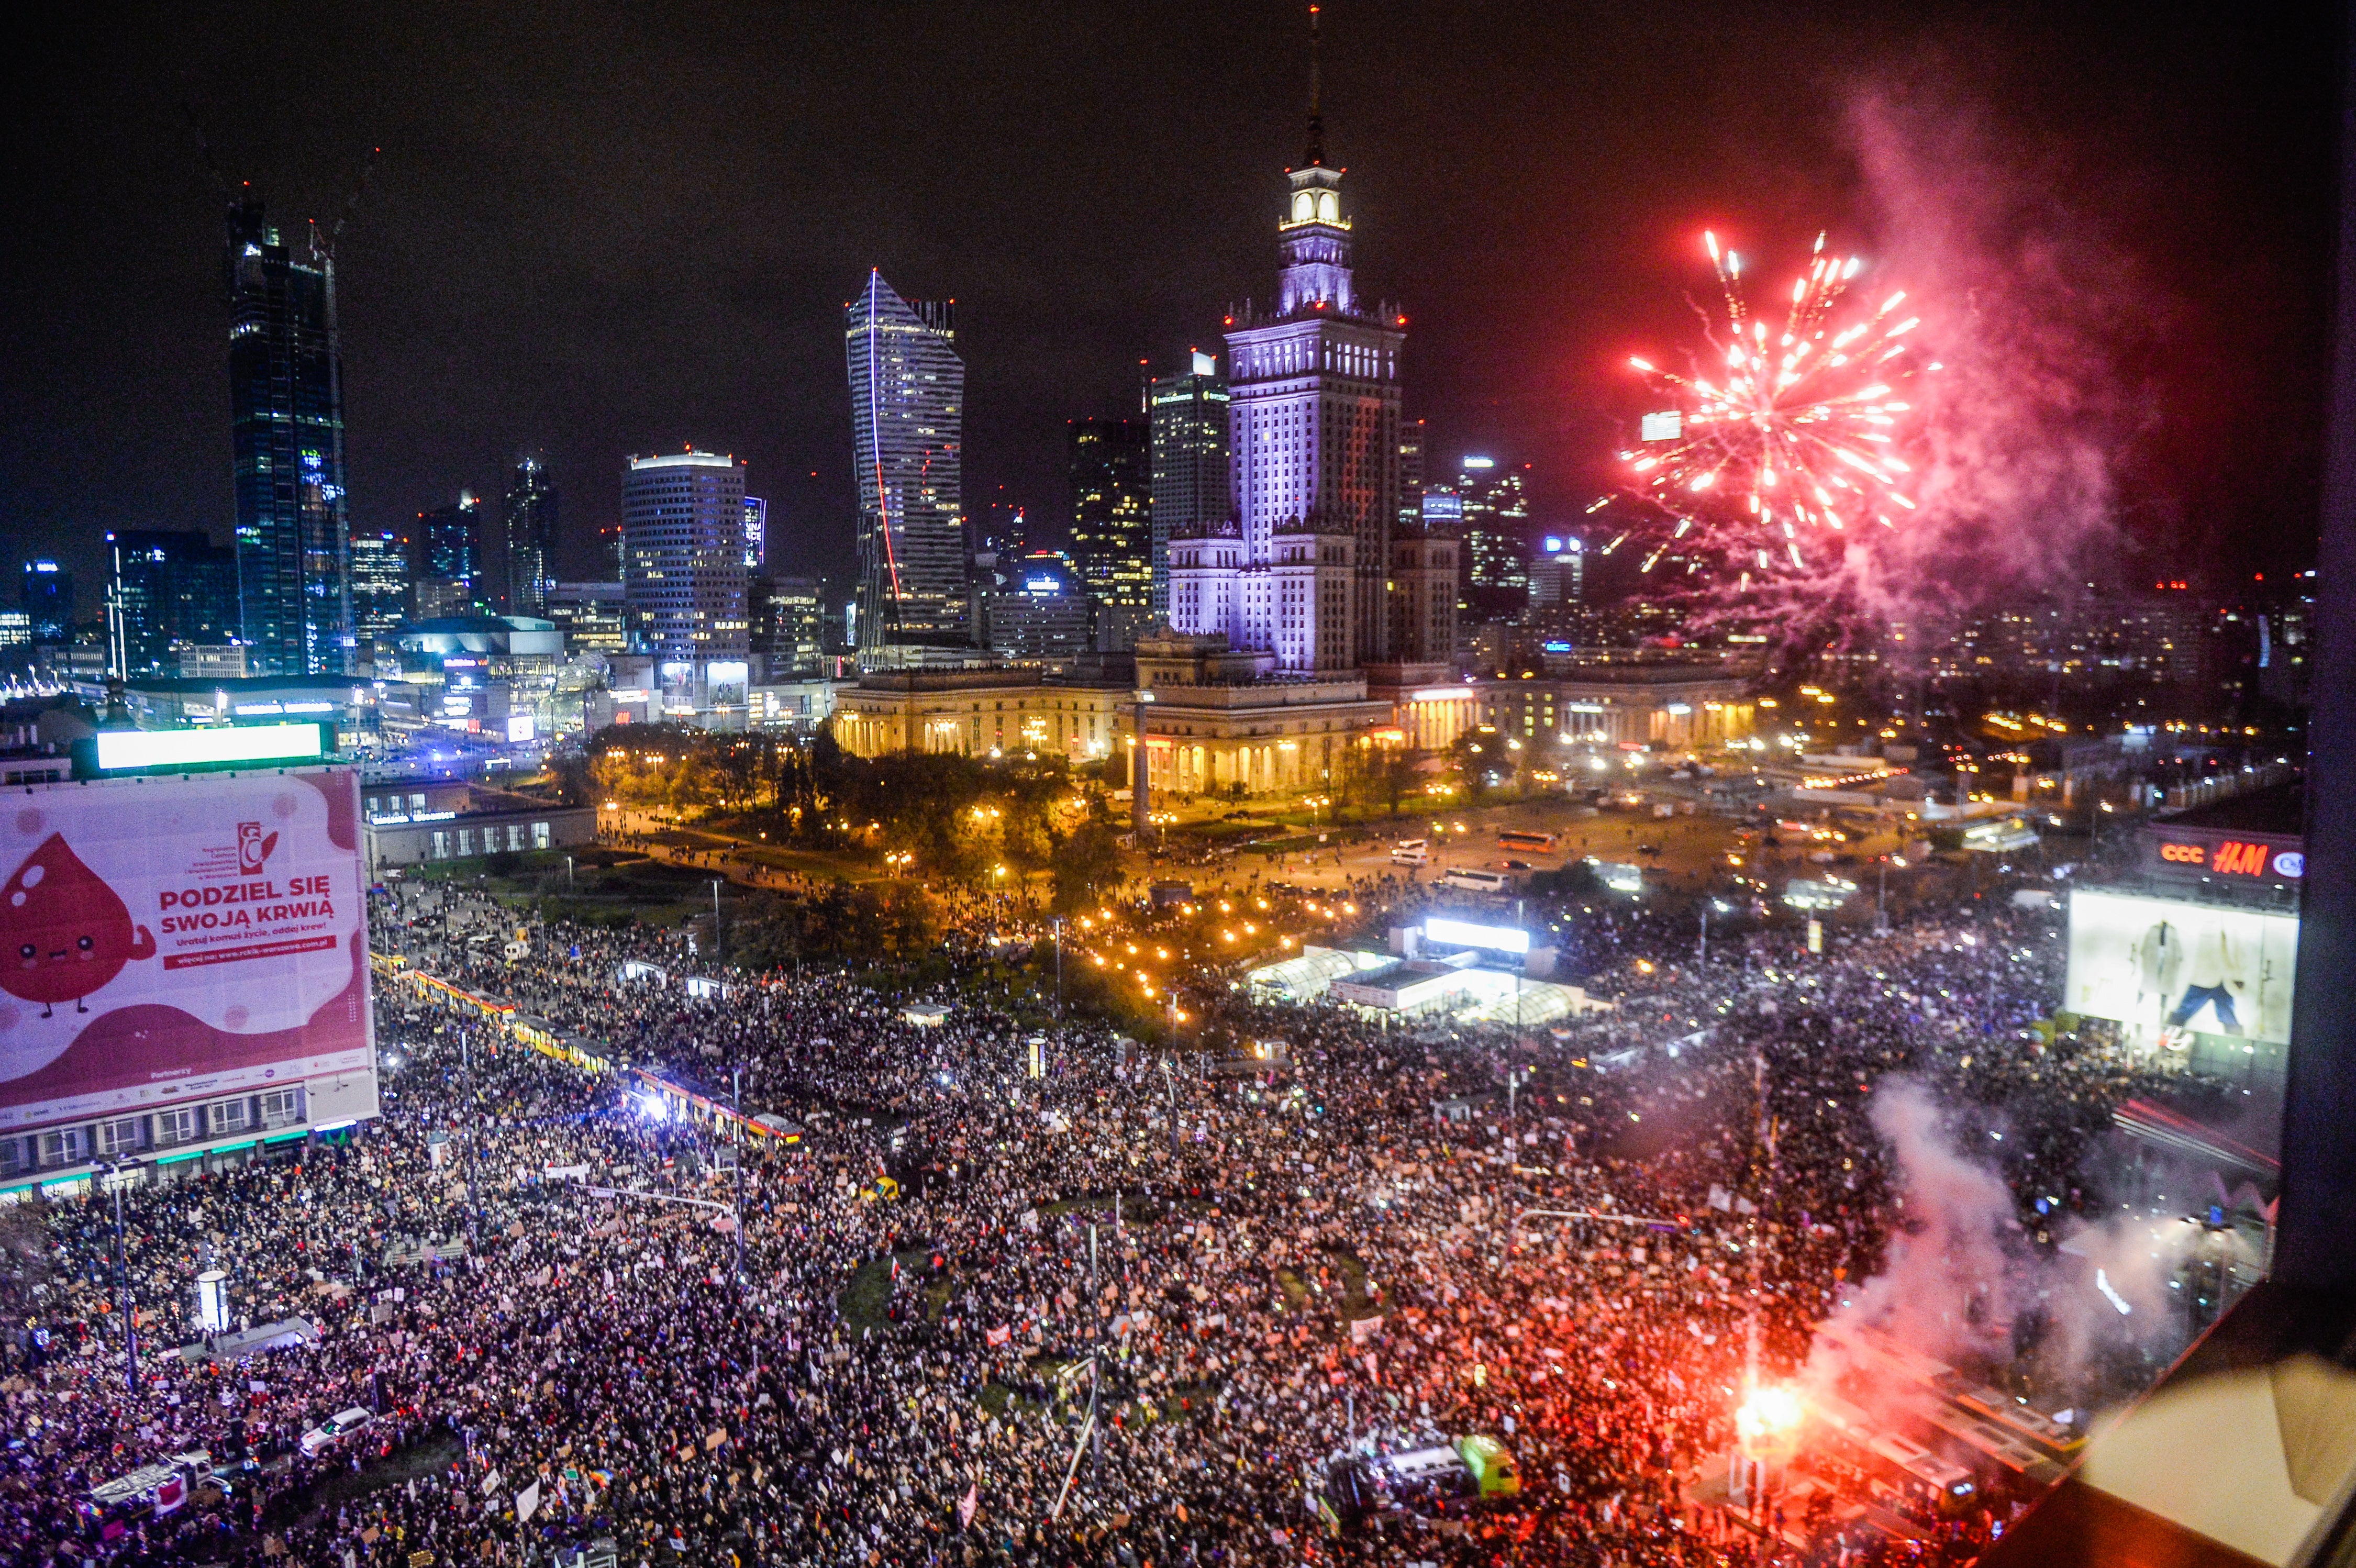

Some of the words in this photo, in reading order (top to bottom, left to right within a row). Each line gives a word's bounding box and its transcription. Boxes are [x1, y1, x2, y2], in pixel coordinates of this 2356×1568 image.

[2213, 841, 2269, 877] H&M
[160, 881, 282, 910] PODZIEL
[290, 875, 330, 898] SIĘ
[161, 909, 251, 933] SWOJĄ
[257, 900, 334, 922] KRWIĄ
[176, 936, 207, 946] Uratuj
[209, 932, 241, 942] komuś
[272, 925, 299, 935] oddaj
